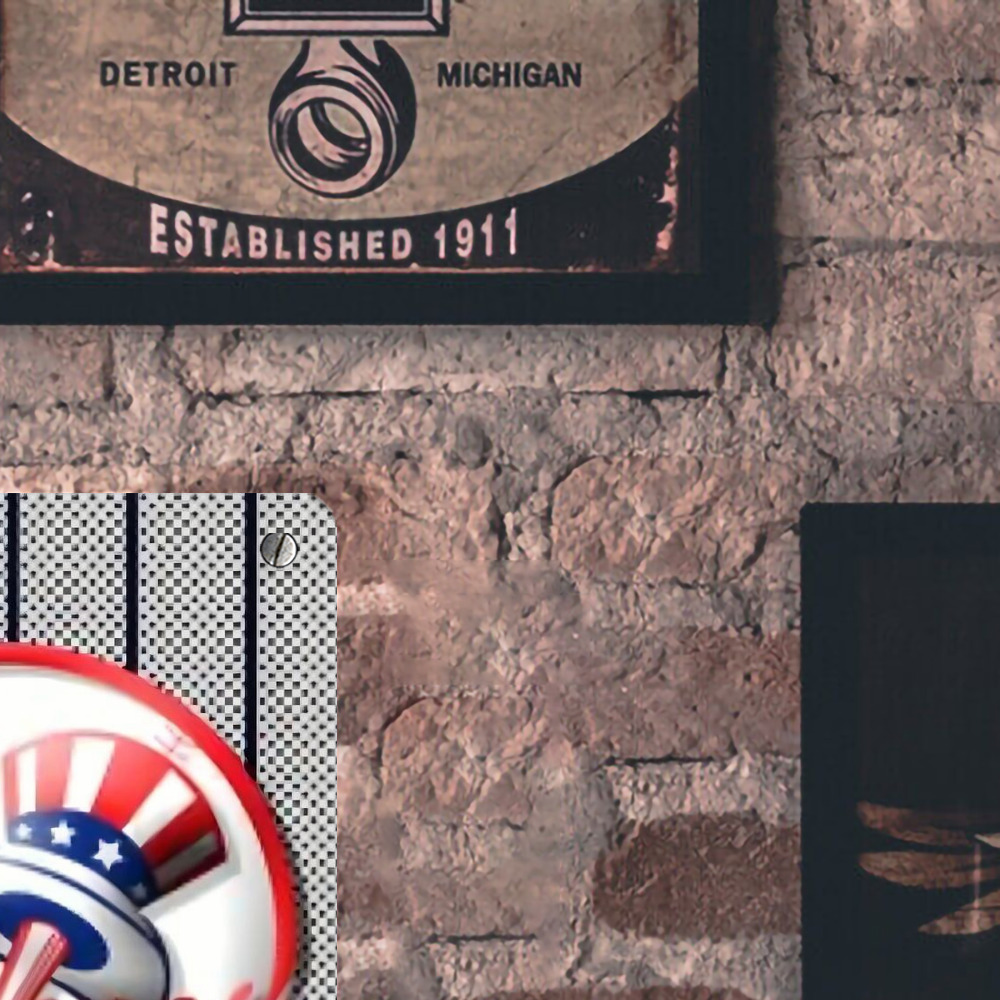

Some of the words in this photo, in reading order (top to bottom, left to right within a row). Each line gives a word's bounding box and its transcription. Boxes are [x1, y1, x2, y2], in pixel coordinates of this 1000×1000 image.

[100, 62, 238, 88] DETROIT
[437, 62, 582, 88] MICHIGAN
[150, 203, 413, 261] ESTABLISHED
[434, 207, 519, 259] 1911
